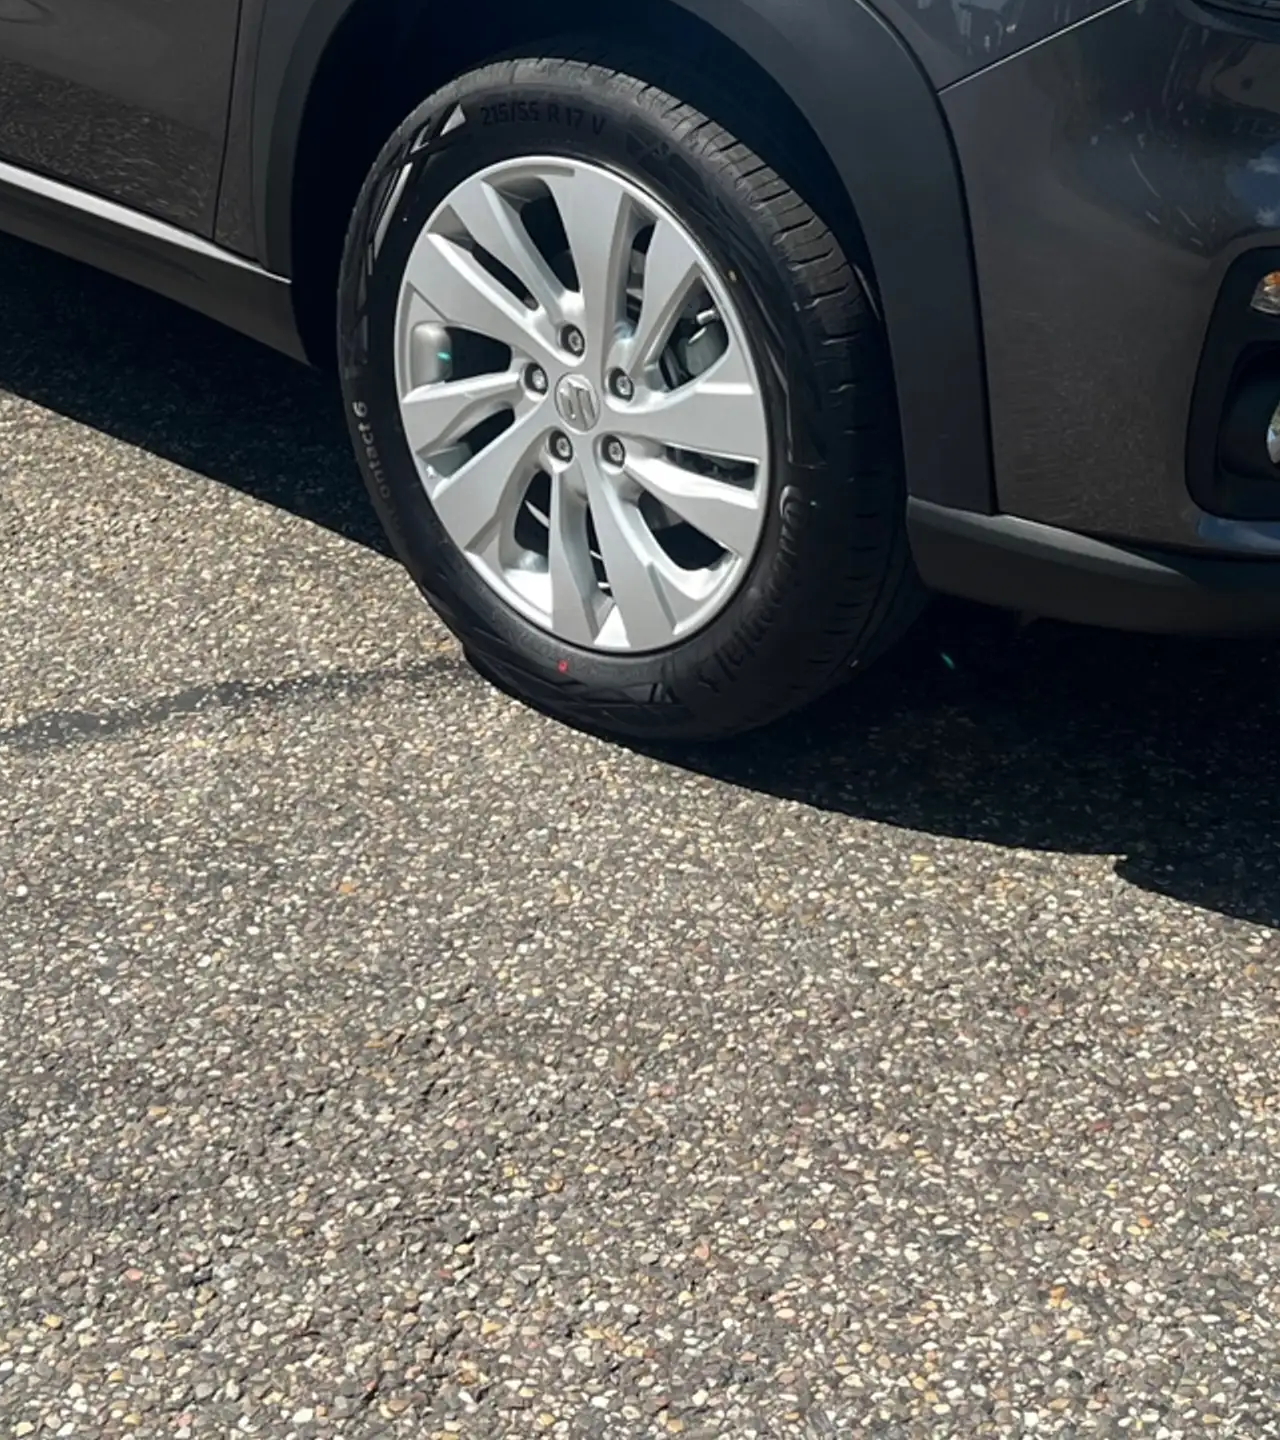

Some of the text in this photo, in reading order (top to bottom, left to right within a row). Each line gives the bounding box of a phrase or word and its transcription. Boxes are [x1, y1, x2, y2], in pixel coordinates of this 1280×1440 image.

[547, 103, 561, 125] R
[565, 107, 585, 131] 17
[591, 113, 607, 136] V
